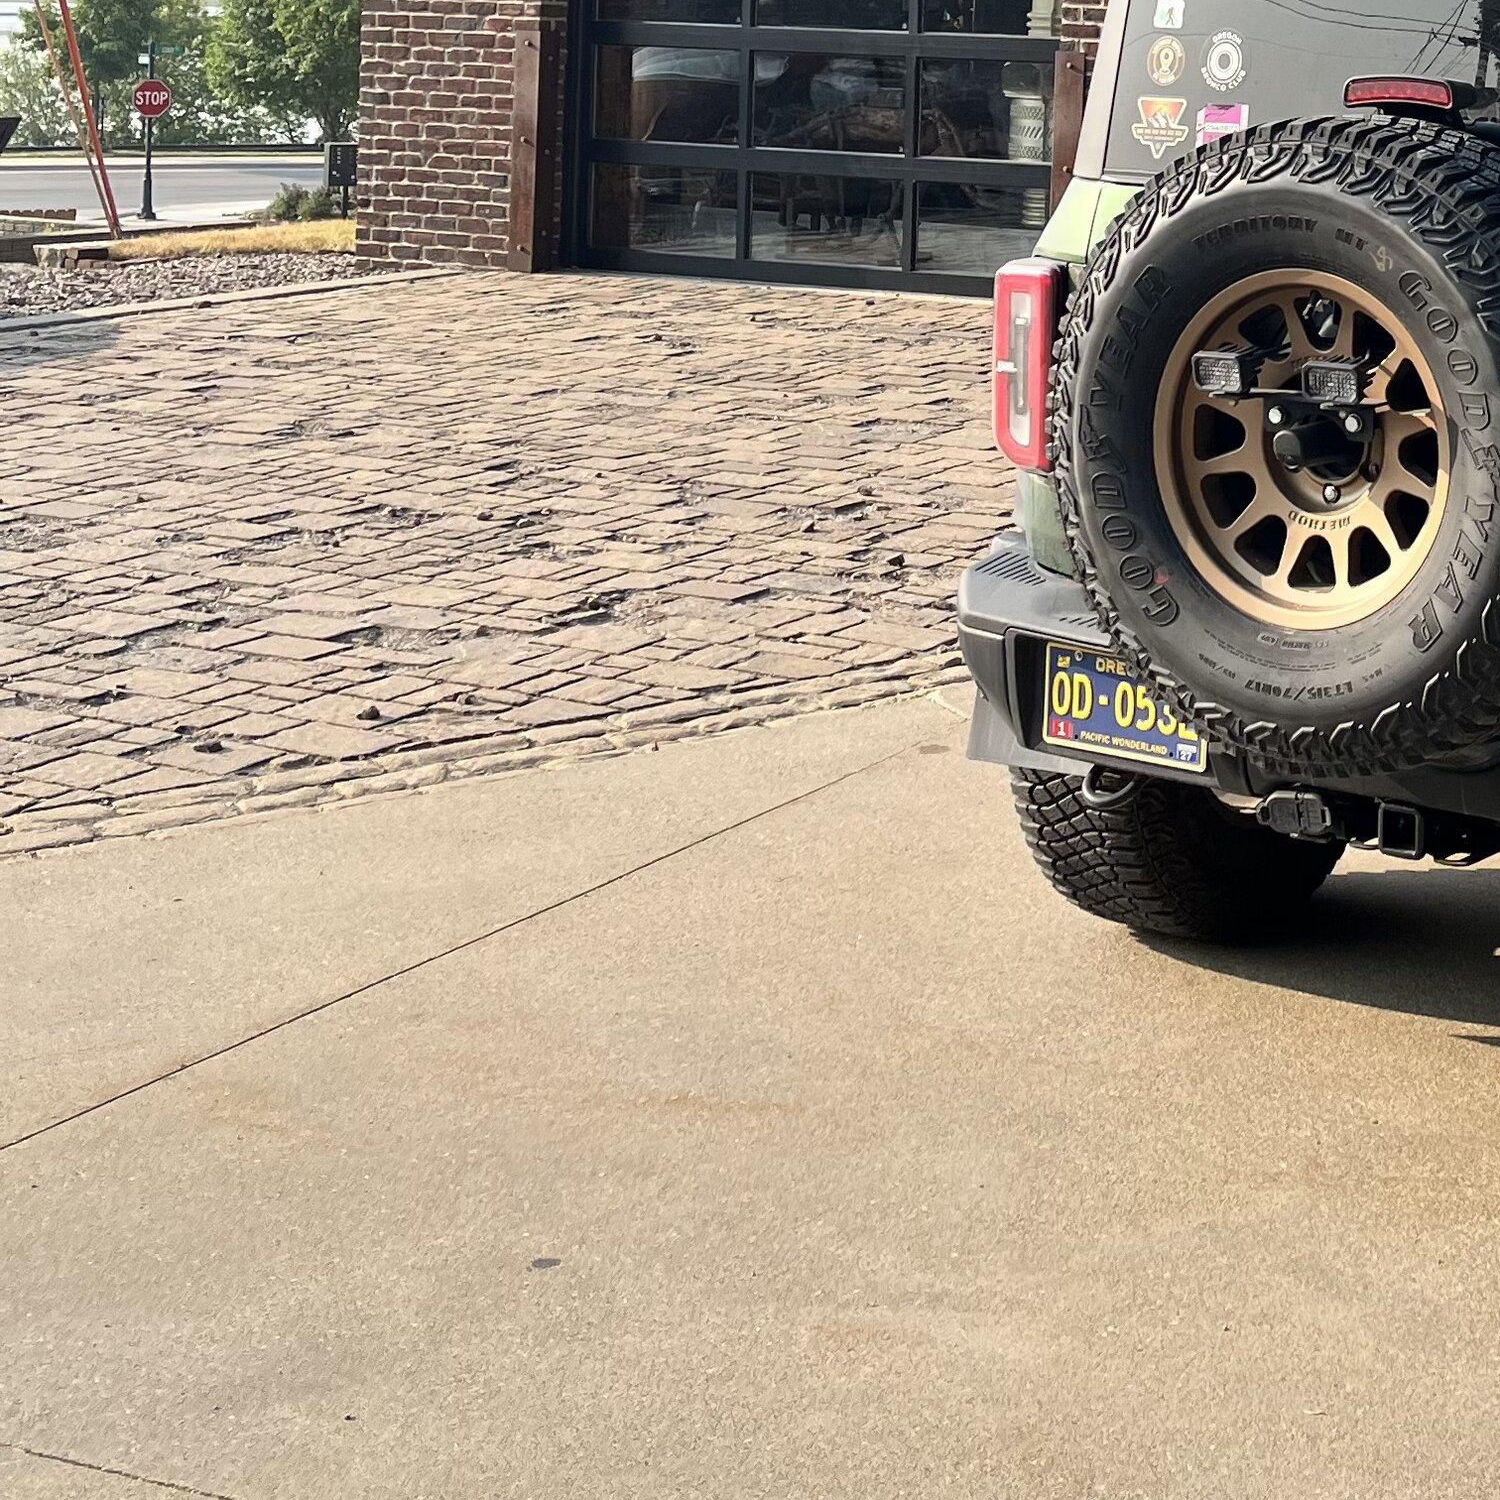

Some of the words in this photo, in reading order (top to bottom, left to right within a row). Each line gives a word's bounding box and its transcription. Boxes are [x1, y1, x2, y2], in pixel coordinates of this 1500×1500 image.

[1211, 31, 1243, 45] OREGON
[1200, 67, 1227, 91] BRONCO
[1228, 69, 1247, 89] CLUB
[135, 91, 168, 106] STOP
[1191, 213, 1318, 250] TERRITORY
[1080, 730, 1111, 746] PACIFIC
[1112, 736, 1168, 756] WONDERLAND
[1179, 750, 1193, 762] 27
